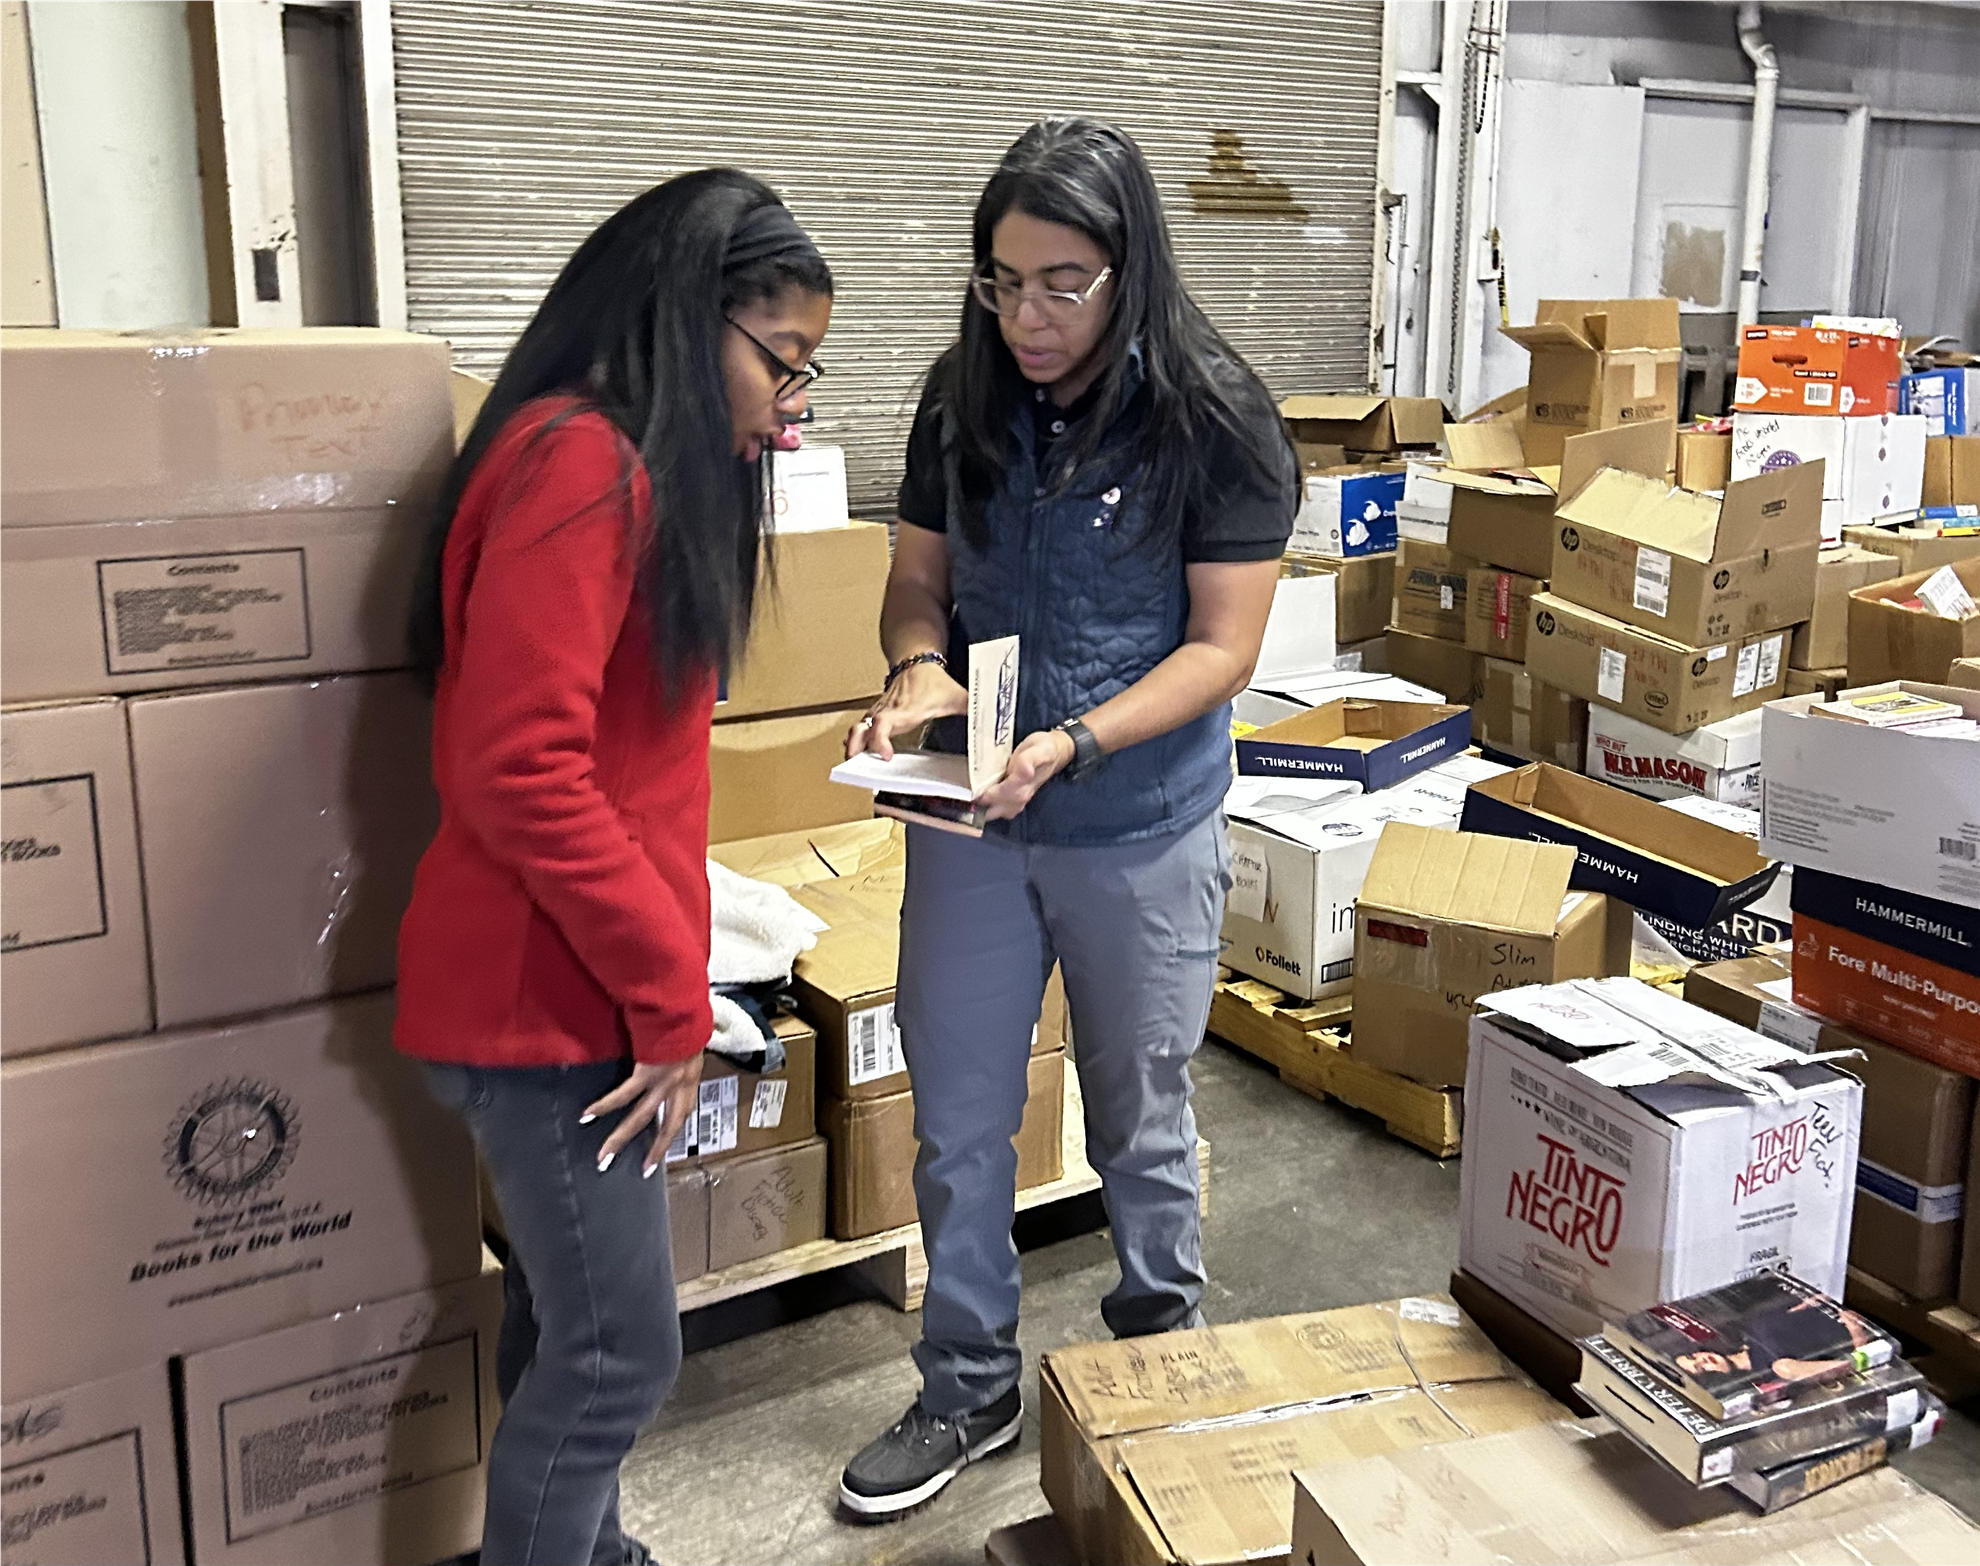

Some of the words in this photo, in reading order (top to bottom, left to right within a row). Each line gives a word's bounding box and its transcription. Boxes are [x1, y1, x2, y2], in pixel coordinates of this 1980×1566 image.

[1558, 622, 1595, 647] Desktop
[1401, 736, 1446, 764] HAMMERMILL
[1596, 736, 1611, 748] WHO
[1611, 741, 1626, 752] BUT
[1257, 756, 1344, 773] HAMMERMILL
[1636, 911, 1704, 939] LINDING
[1709, 935, 1749, 954] WHIT
[1855, 897, 1970, 947] HAMMERMILL
[1266, 949, 1301, 977] Follett
[1490, 943, 1535, 966] Slim
[1693, 939, 1737, 959] PAPER
[1828, 945, 1866, 972] Fore
[1872, 961, 1980, 1015] Multi-Purpo
[1751, 1115, 1807, 1162] TINTO
[1537, 1132, 1627, 1240] TINTO
[1733, 1138, 1807, 1206] NEGRO
[1506, 1169, 1622, 1268] NEGRO
[130, 1252, 201, 1283] Books
[208, 1243, 242, 1263] for
[247, 1232, 284, 1252] the
[289, 1211, 352, 1242] World
[310, 1367, 398, 1402] Contents
